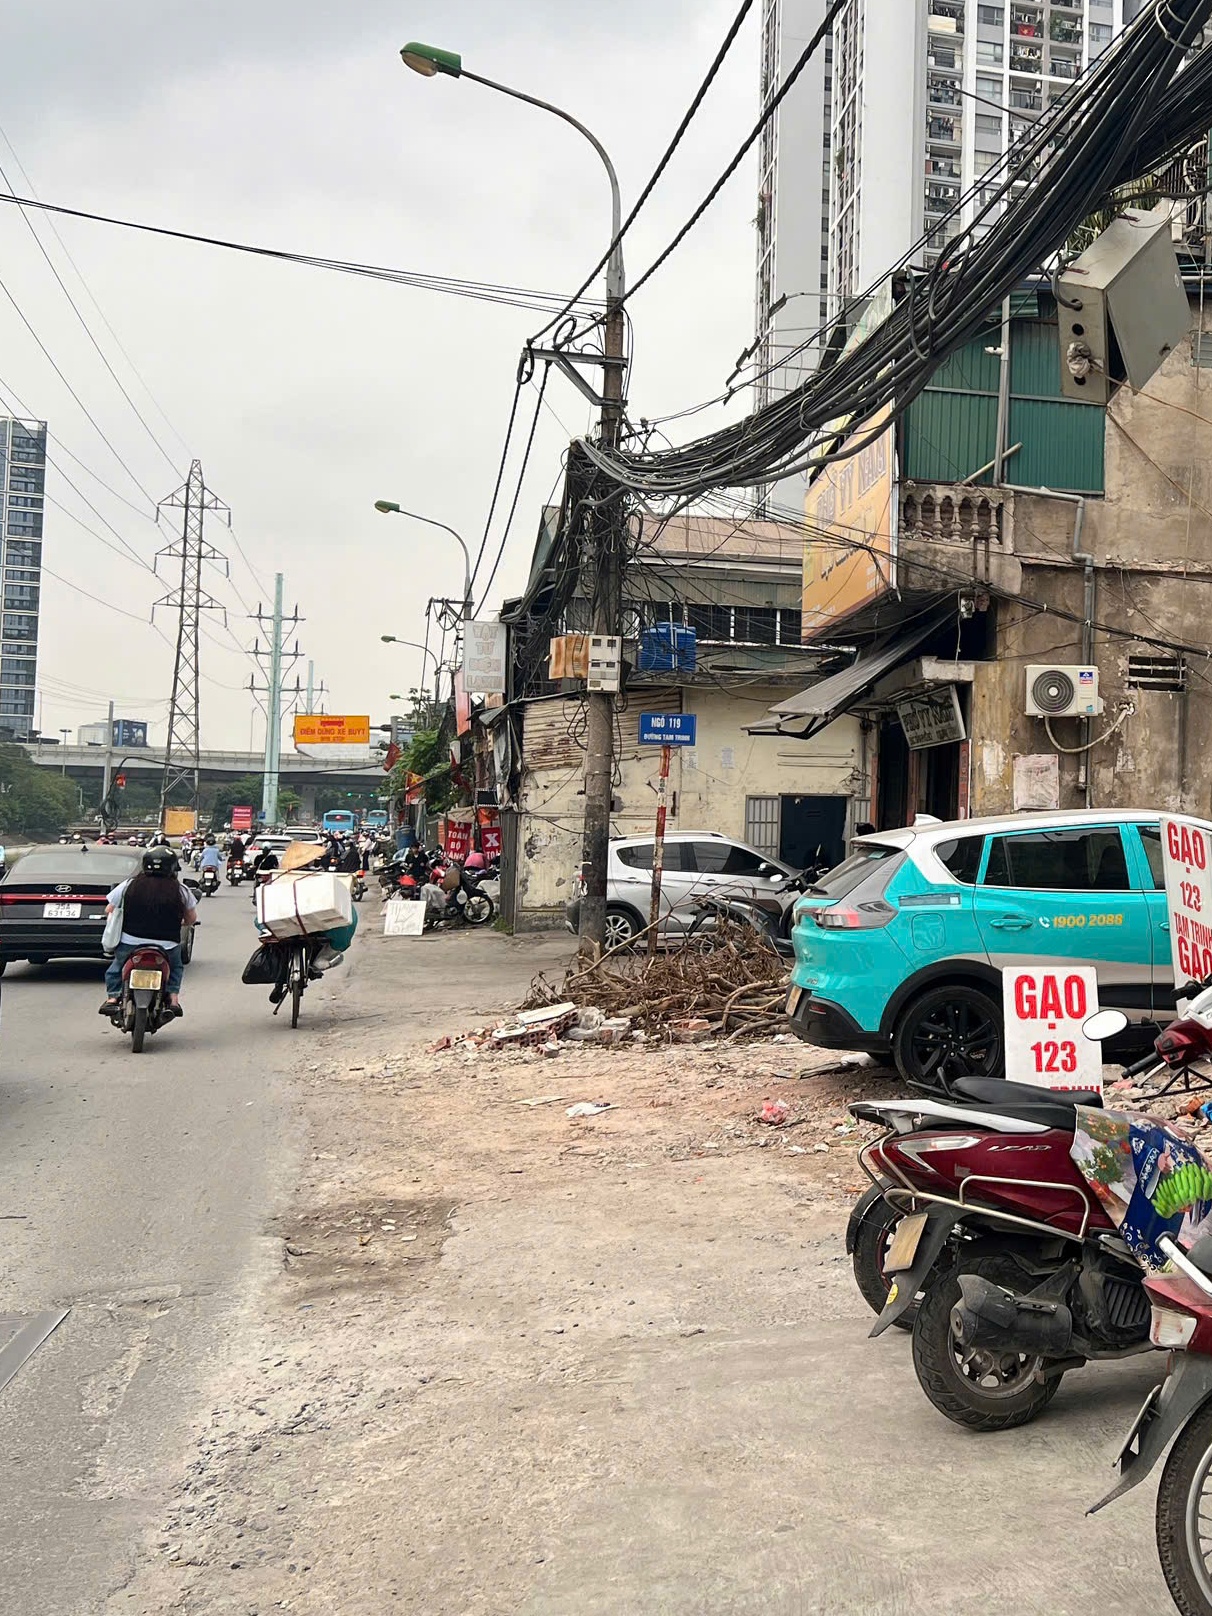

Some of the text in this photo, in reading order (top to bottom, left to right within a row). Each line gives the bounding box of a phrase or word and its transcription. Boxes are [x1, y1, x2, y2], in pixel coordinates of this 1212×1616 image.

[669, 718, 681, 728] 119
[1167, 821, 1206, 874] GẠO
[1180, 881, 1202, 912] 123
[1053, 914, 1123, 928] 1900 2088
[1173, 912, 1189, 937] TAM
[1014, 974, 1087, 1030] GẠO
[1030, 1040, 1077, 1073] 123
[986, 1144, 1052, 1152] LEAD
